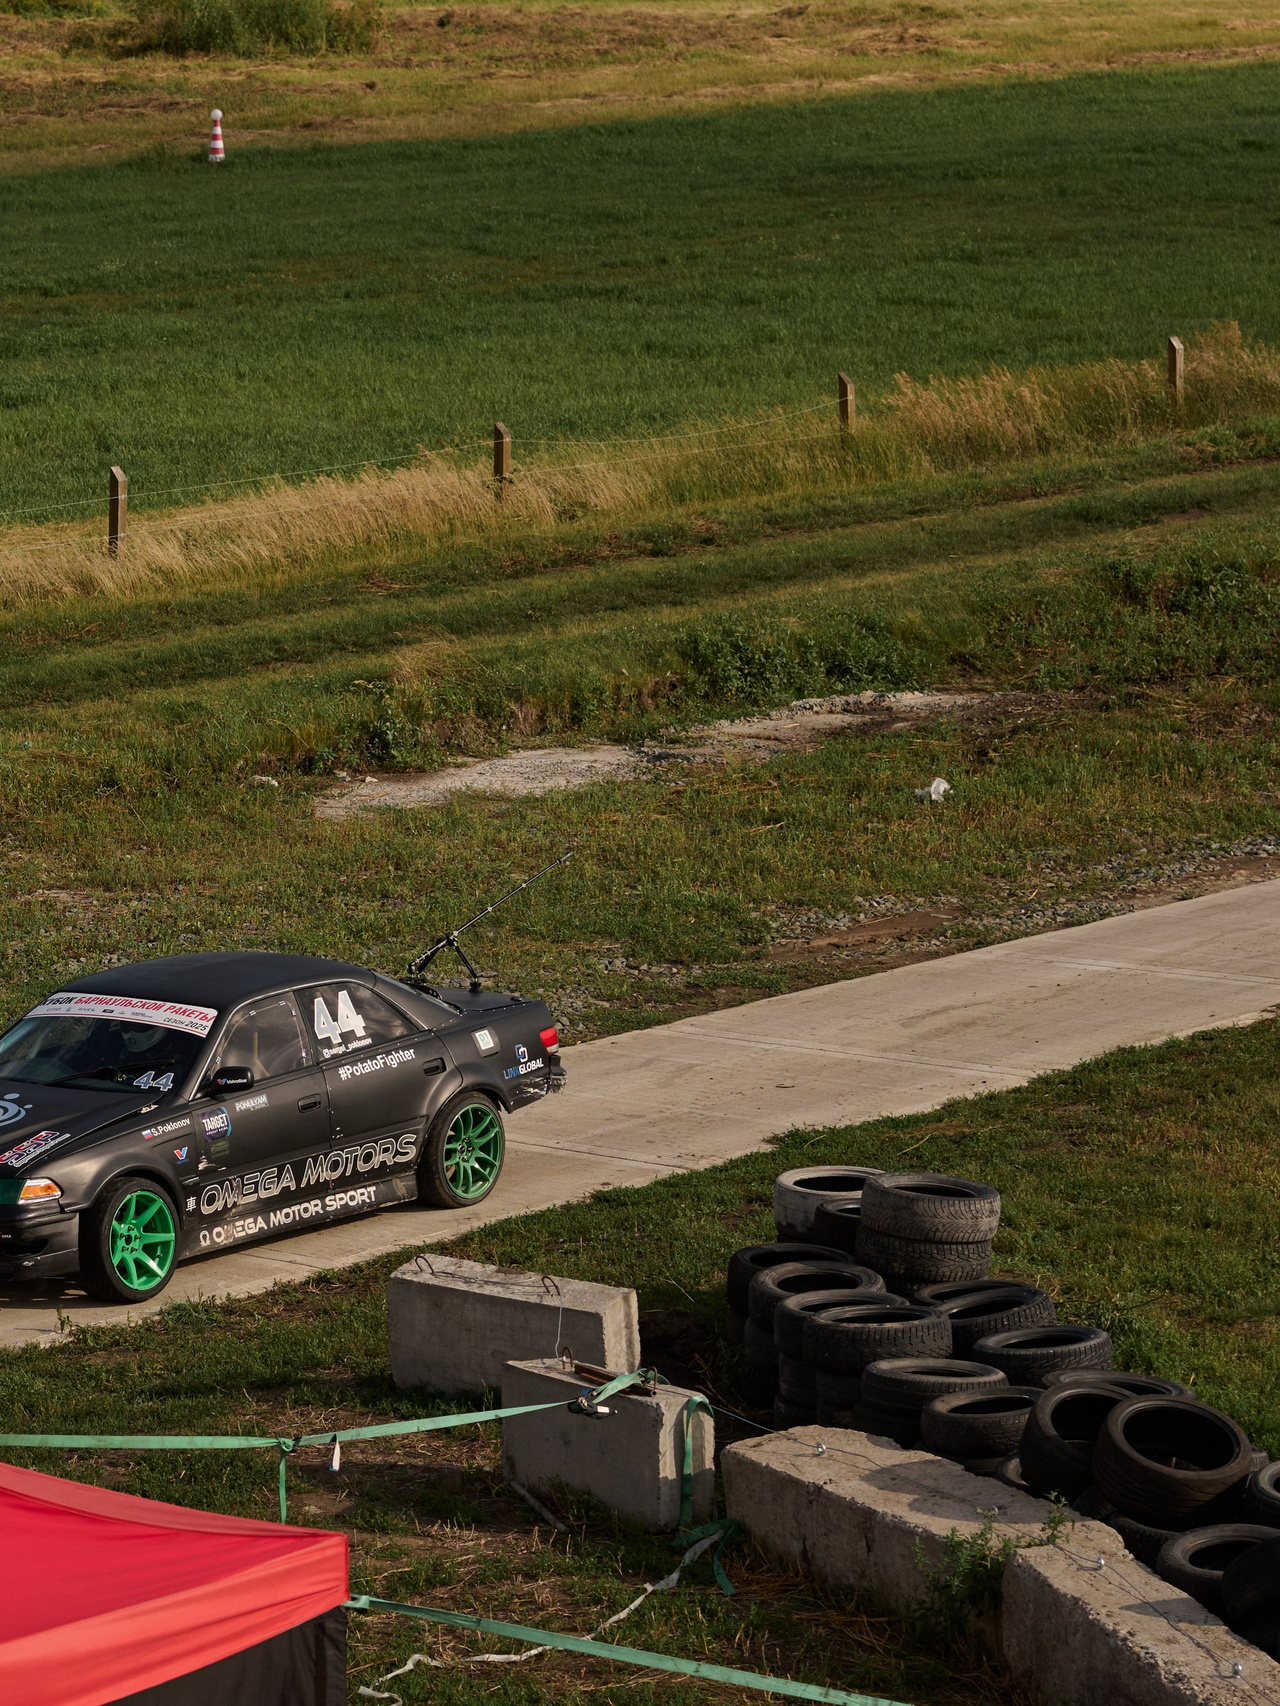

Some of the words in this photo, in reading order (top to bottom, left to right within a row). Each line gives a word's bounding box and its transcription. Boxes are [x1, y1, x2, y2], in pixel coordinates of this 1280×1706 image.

[74, 996, 166, 1013] БАРНАУЛЬСКОЙ
[164, 1004, 217, 1023] РАКЕТЫ
[313, 989, 367, 1045] 44
[185, 1020, 210, 1032] 2025
[338, 1048, 417, 1081] #PotatoFighter
[132, 1070, 175, 1092] 44
[150, 1117, 191, 1137] S.Poklonov
[202, 1113, 229, 1132] TARGET
[200, 1164, 296, 1216] OMEGA
[300, 1133, 418, 1188] MOTORS
[269, 1198, 324, 1230] MOTOR
[325, 1185, 377, 1213] SPORT
